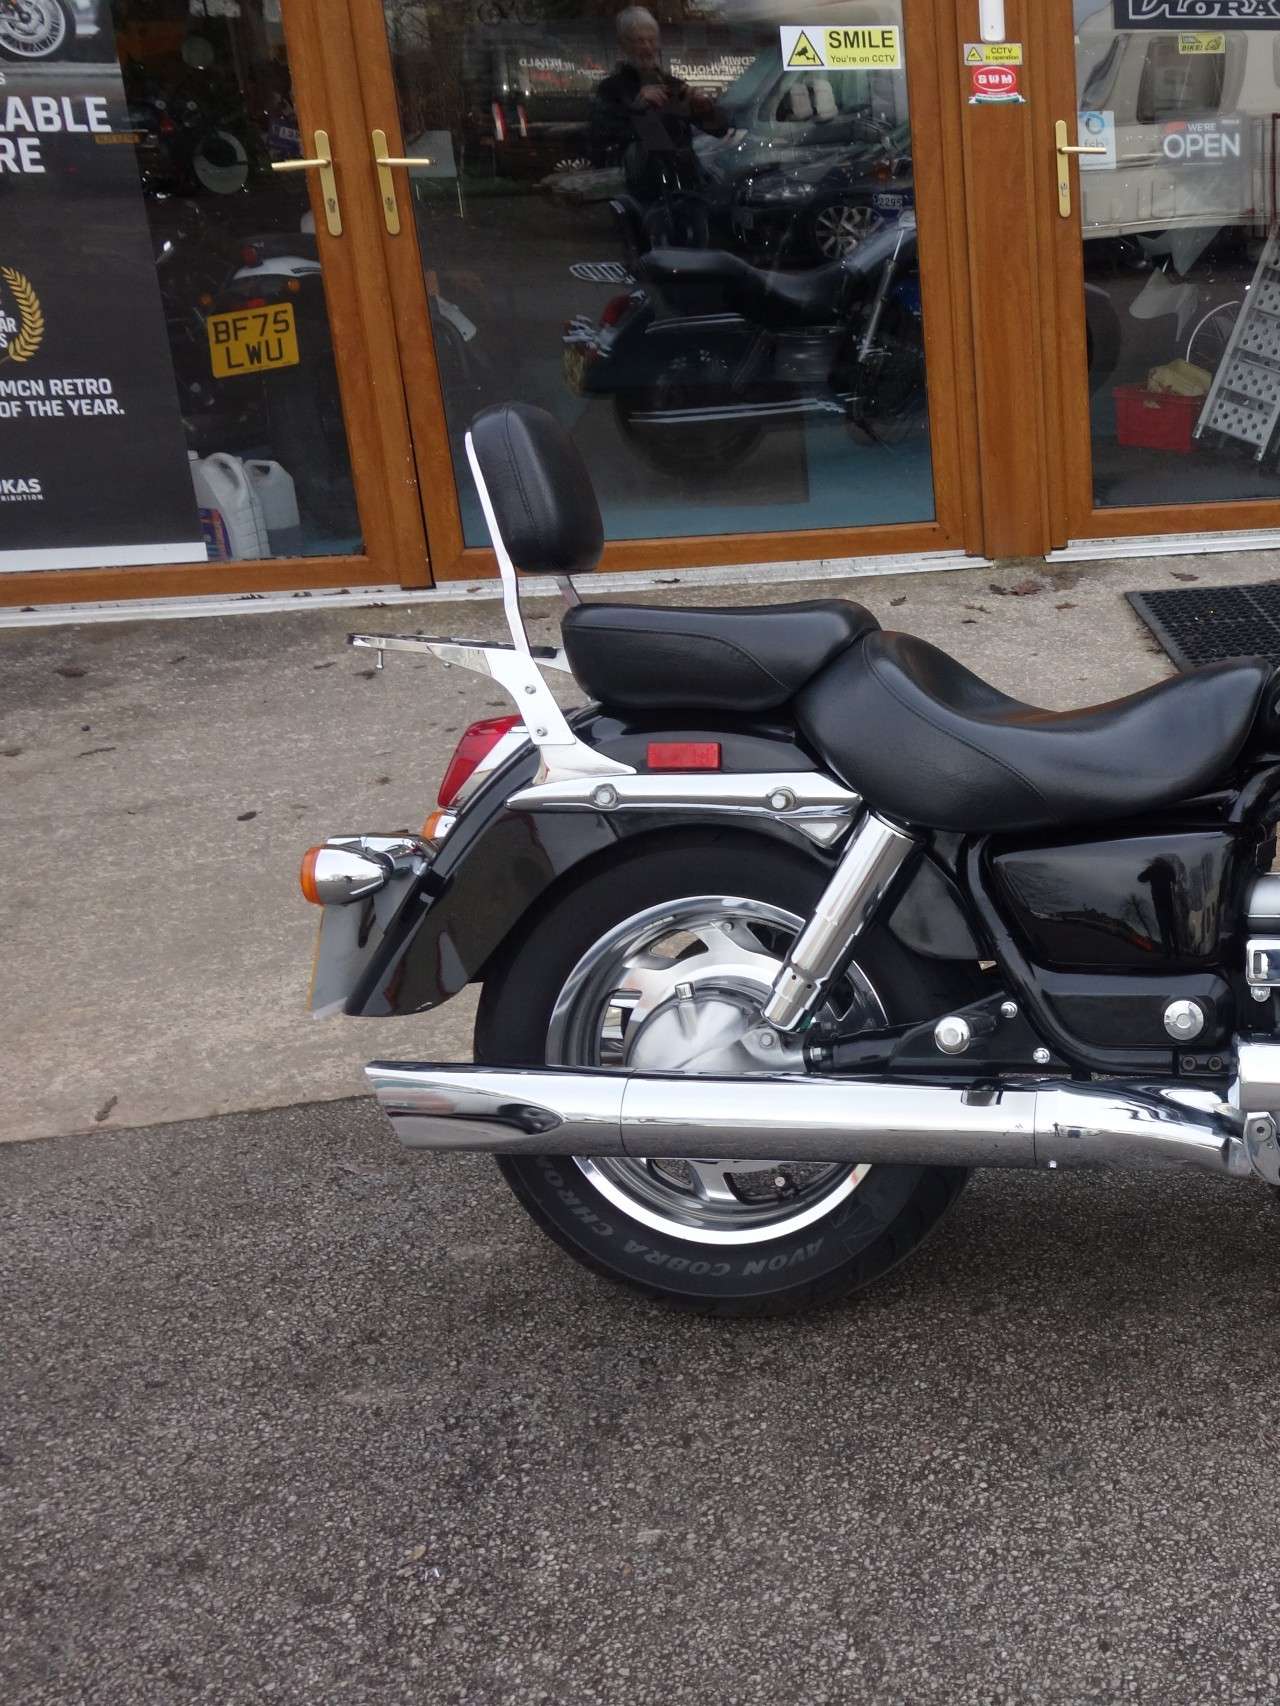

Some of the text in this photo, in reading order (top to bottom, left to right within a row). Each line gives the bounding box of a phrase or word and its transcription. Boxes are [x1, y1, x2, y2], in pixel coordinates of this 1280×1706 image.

[828, 30, 895, 49] SMILE
[830, 55, 857, 63] You're
[872, 55, 895, 63] CCTV
[1163, 133, 1241, 159] OPEN
[212, 309, 290, 345] BF75
[225, 338, 284, 369] LWU
[0, 378, 113, 397] MCN RETRO
[0, 398, 125, 418] OF THE YEAR.
[0, 478, 42, 495] KAS
[624, 1239, 731, 1277] COBRA
[742, 1236, 825, 1276] AVON
